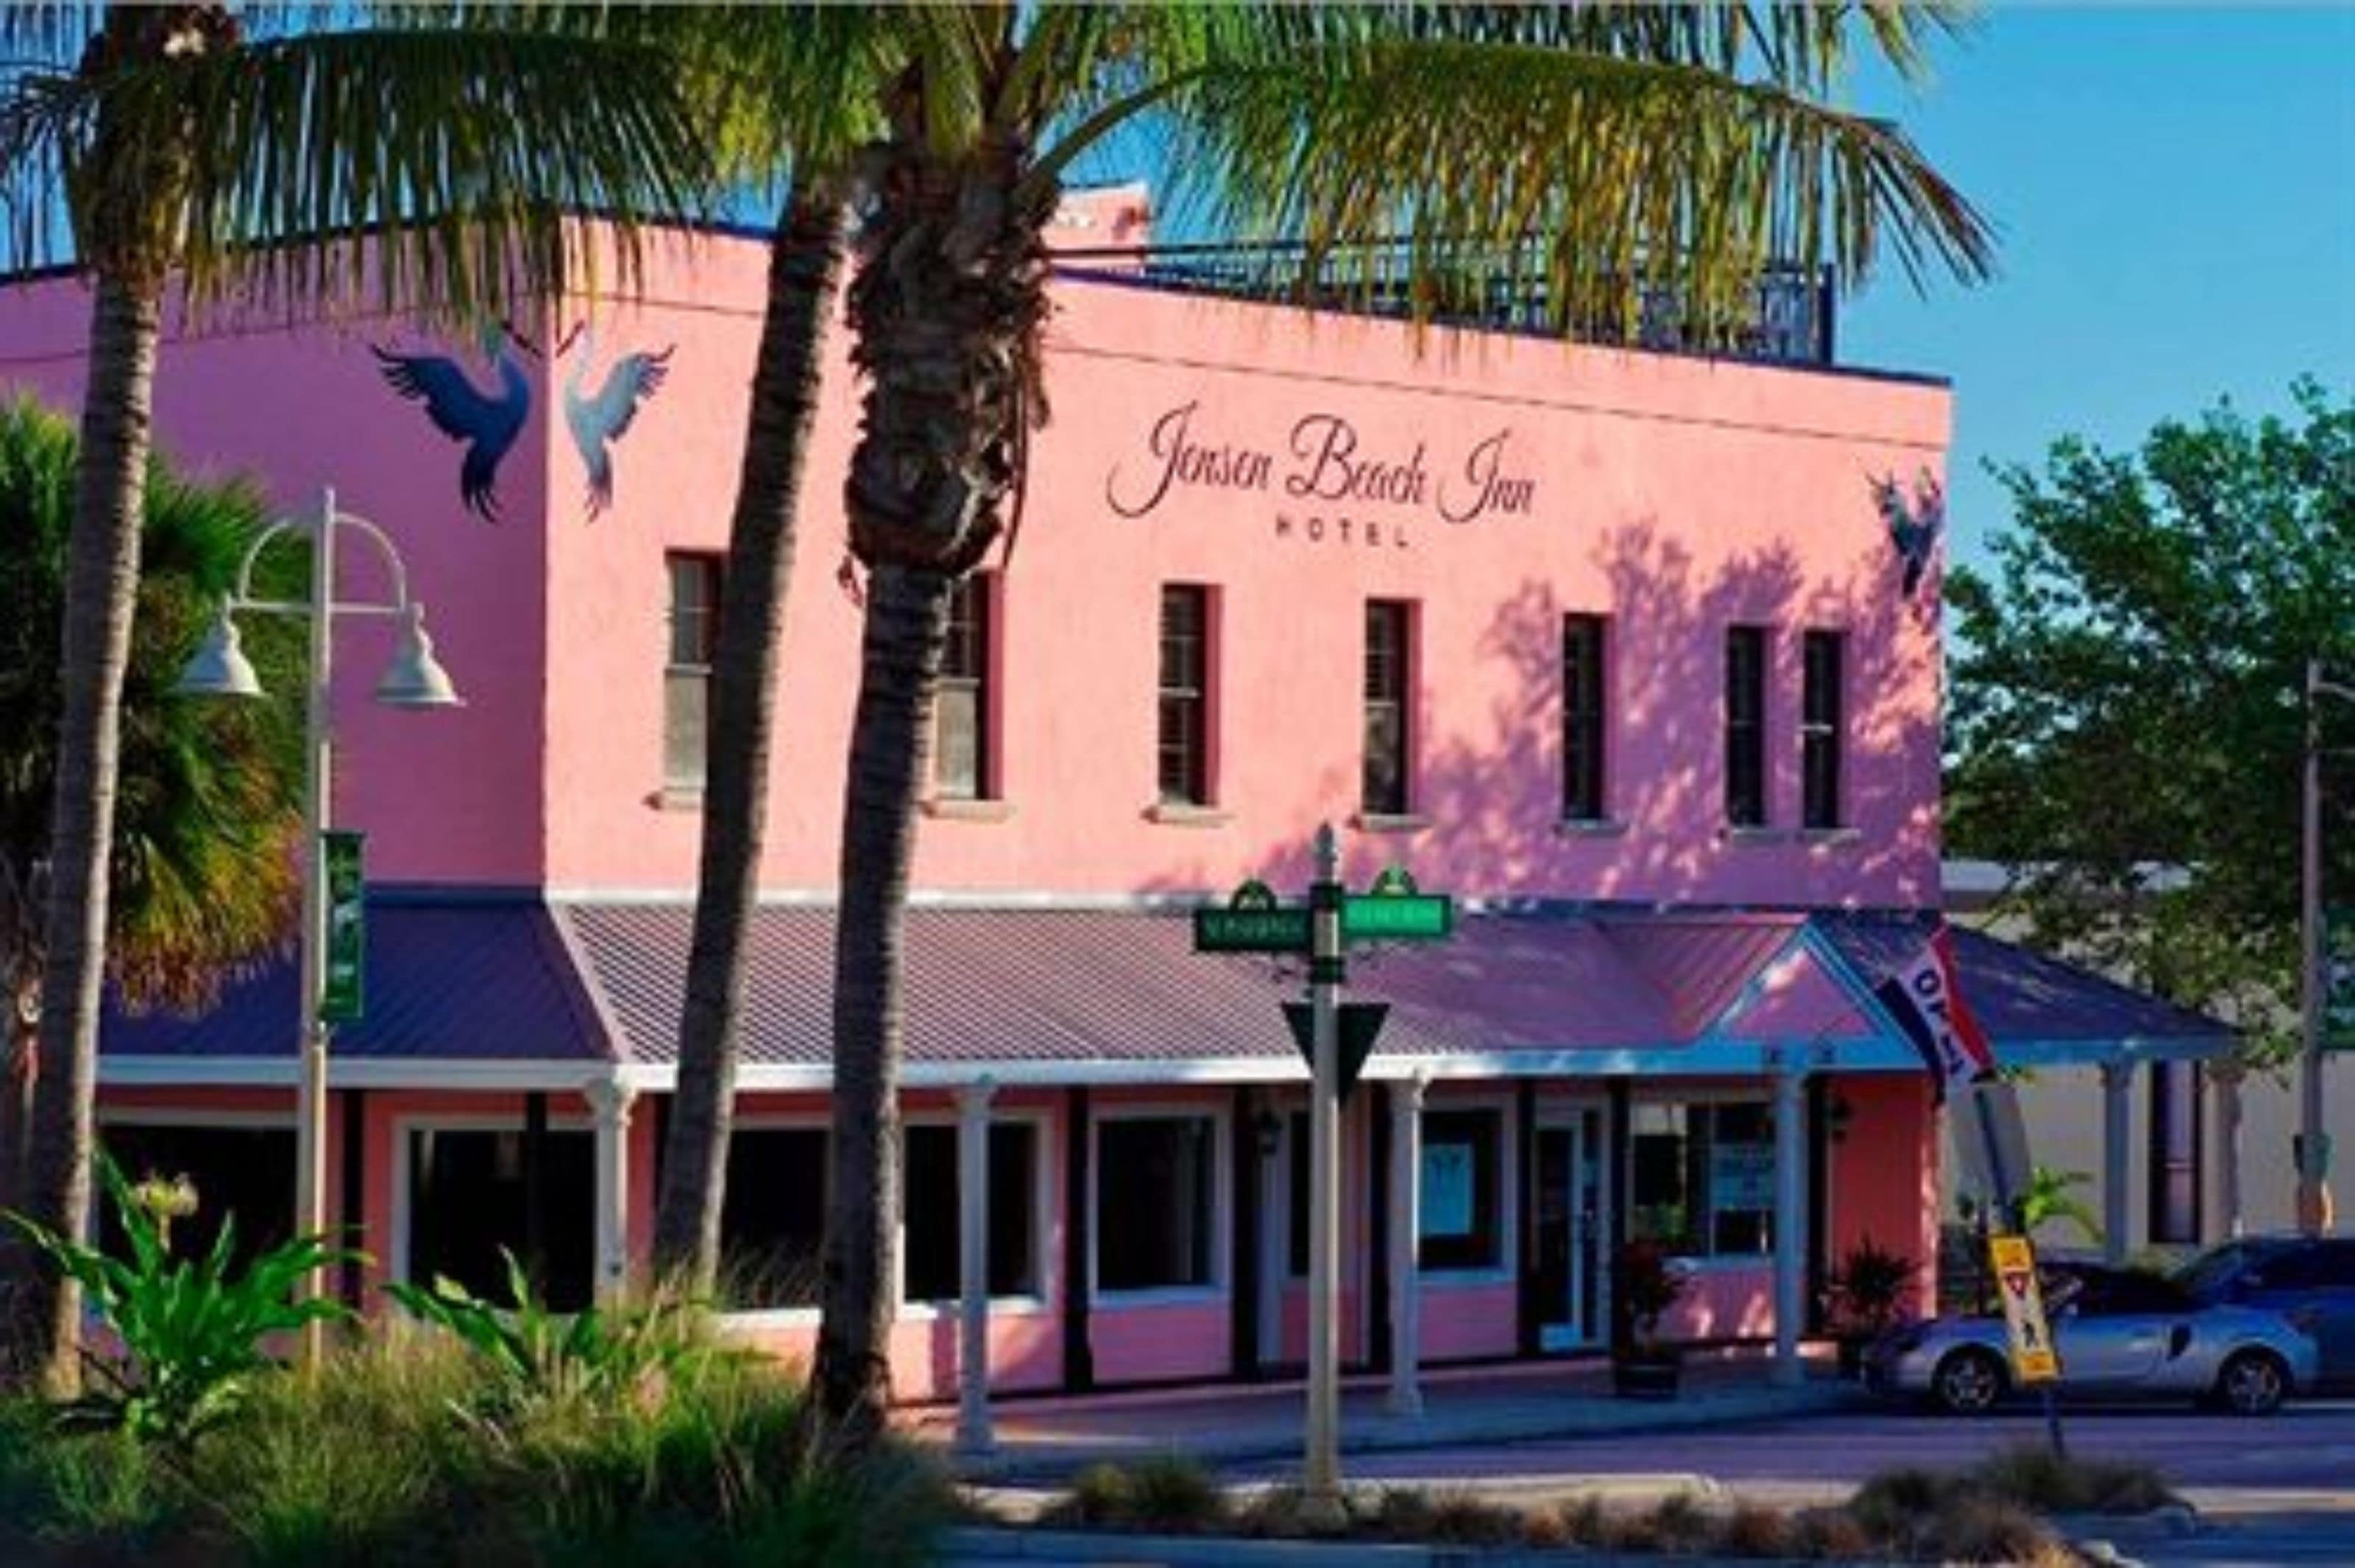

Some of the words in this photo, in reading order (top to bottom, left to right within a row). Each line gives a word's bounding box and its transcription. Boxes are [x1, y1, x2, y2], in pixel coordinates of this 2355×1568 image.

[1106, 399, 1272, 517] Jensen
[1285, 413, 1426, 504] Beach
[1437, 428, 1536, 523] Inn
[1275, 517, 1409, 547] HOTEL
